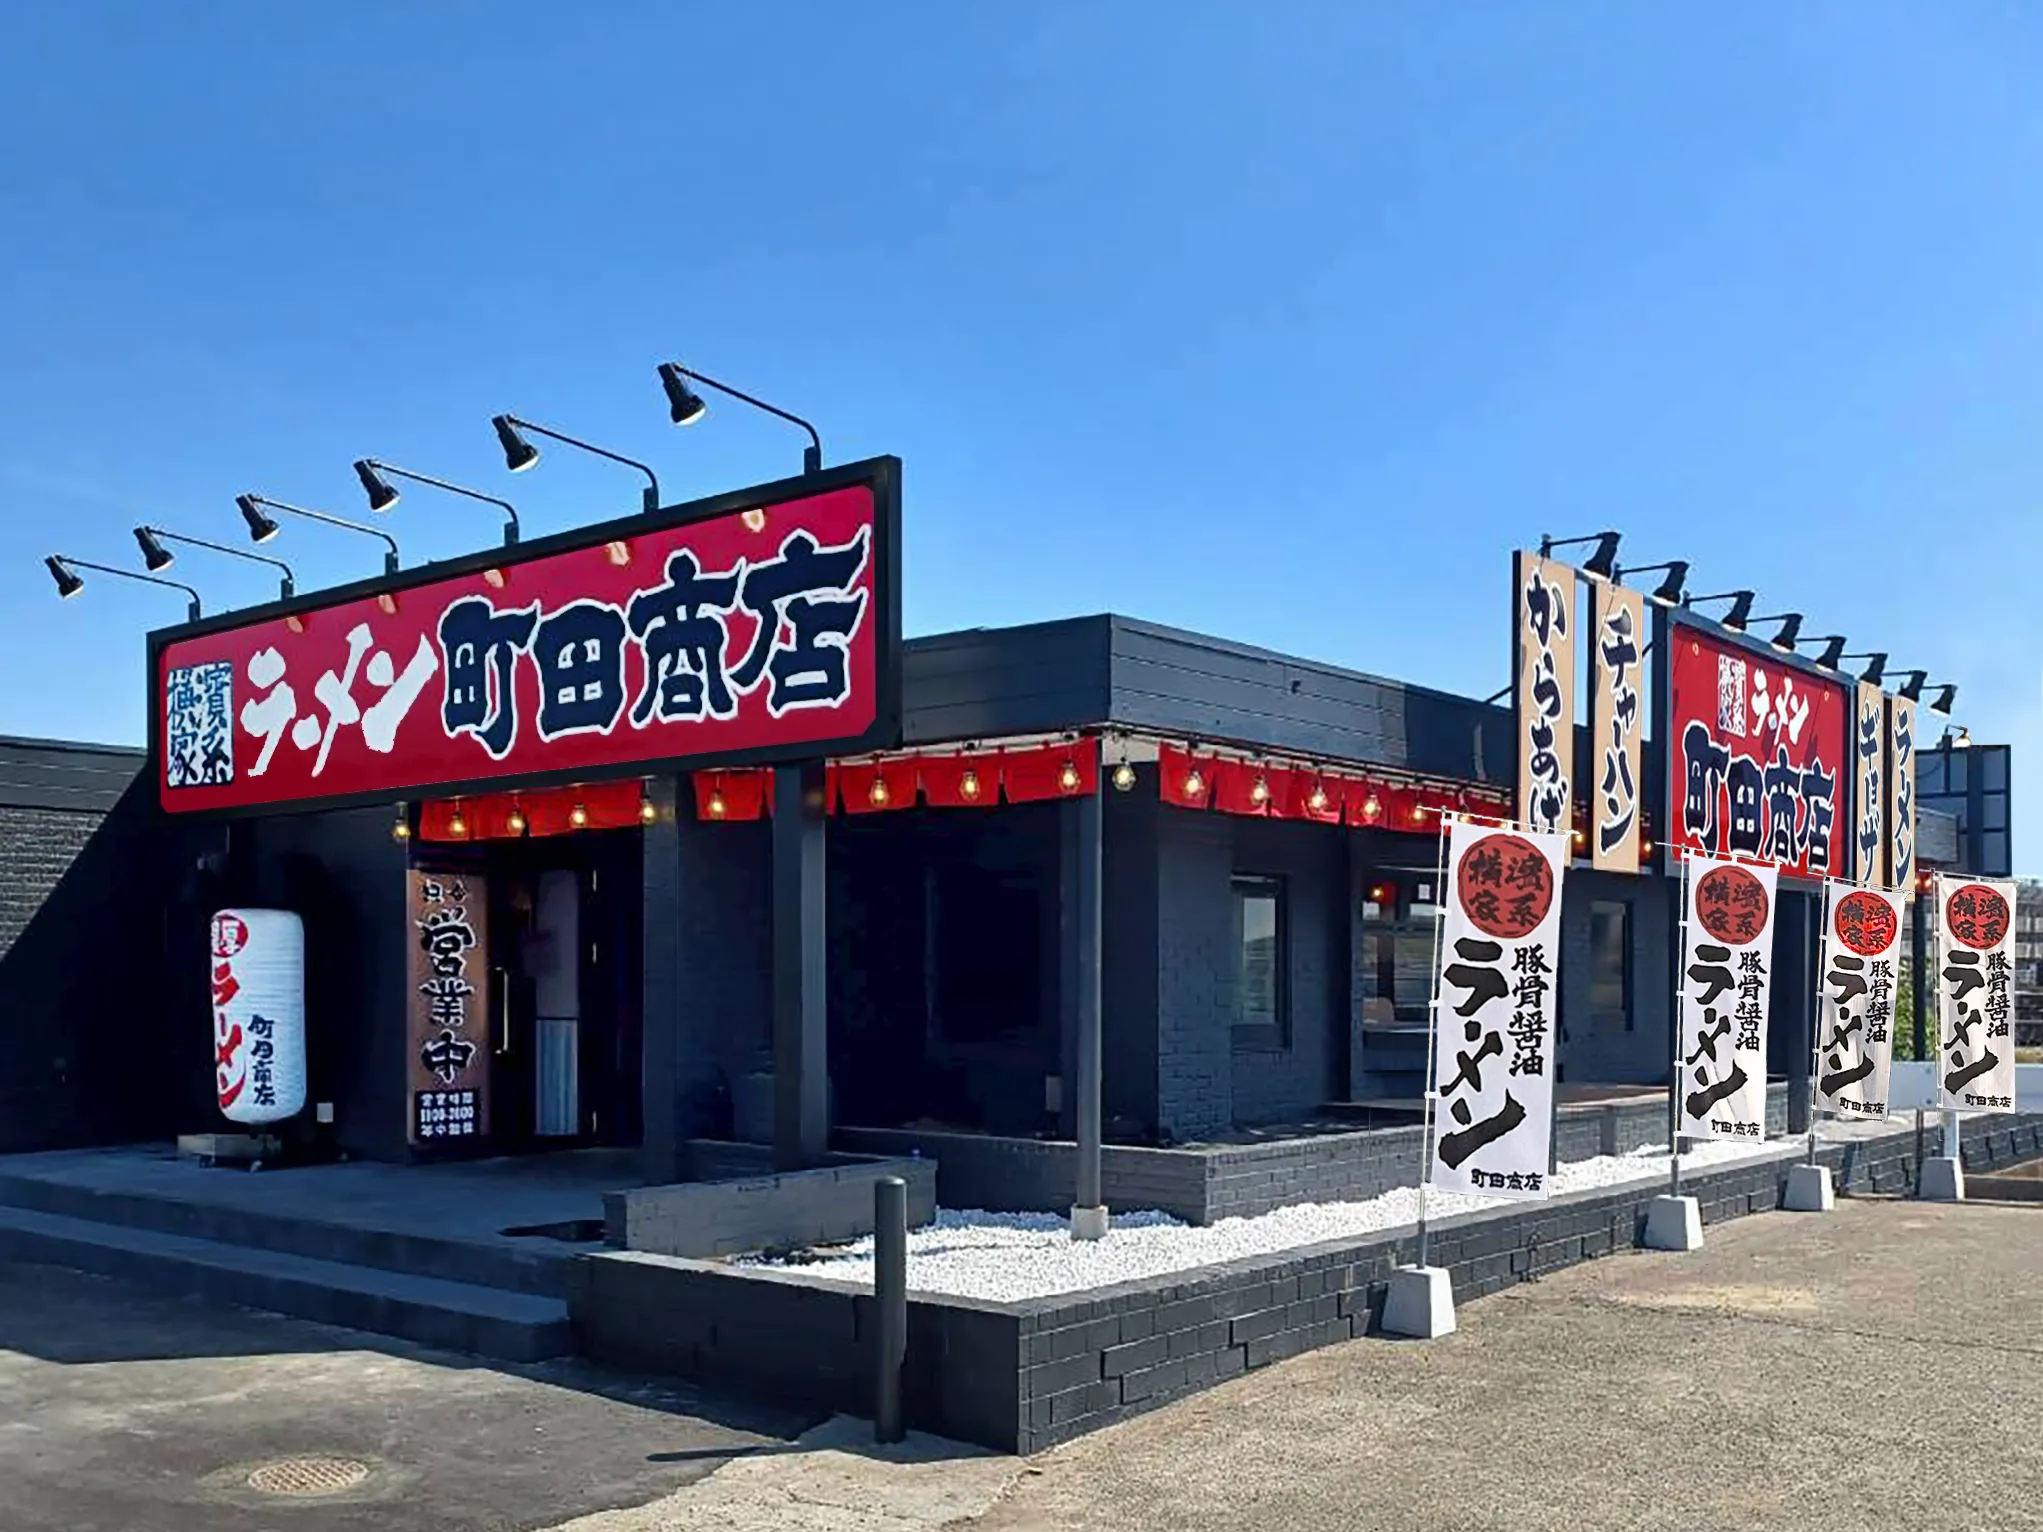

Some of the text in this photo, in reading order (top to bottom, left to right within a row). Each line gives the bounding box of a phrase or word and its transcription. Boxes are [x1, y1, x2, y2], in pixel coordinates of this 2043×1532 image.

[240, 623, 439, 777] ラーメン
[437, 524, 873, 760] 町田商店
[1525, 568, 1570, 834] からあげ
[1751, 668, 1810, 746] ラーメン
[1599, 606, 1639, 852] チャーハン
[1681, 719, 1837, 872] 町田商店
[1893, 706, 1913, 888] ラーメン
[211, 961, 247, 1109] ラーメン
[248, 1014, 276, 1106] 町田商店
[416, 905, 476, 1084] 営業中
[1438, 937, 1527, 1170] ラーメン
[1507, 943, 1552, 1077] 豚骨醤油
[1685, 944, 1748, 1119] ラーメン
[1734, 951, 1767, 1052] 豚骨醤油
[1820, 954, 1875, 1097] ラーメン
[1865, 960, 1895, 1044] 豚骨醤油
[1942, 950, 1999, 1095] ラーメン
[1984, 950, 2012, 1039] 豚骨醤油
[1711, 1119, 1761, 1136] 町田商店
[1839, 1096, 1885, 1115] 町田商店
[1965, 1093, 2012, 1108] 町田商店
[1471, 1168, 1543, 1191] 町田商店
